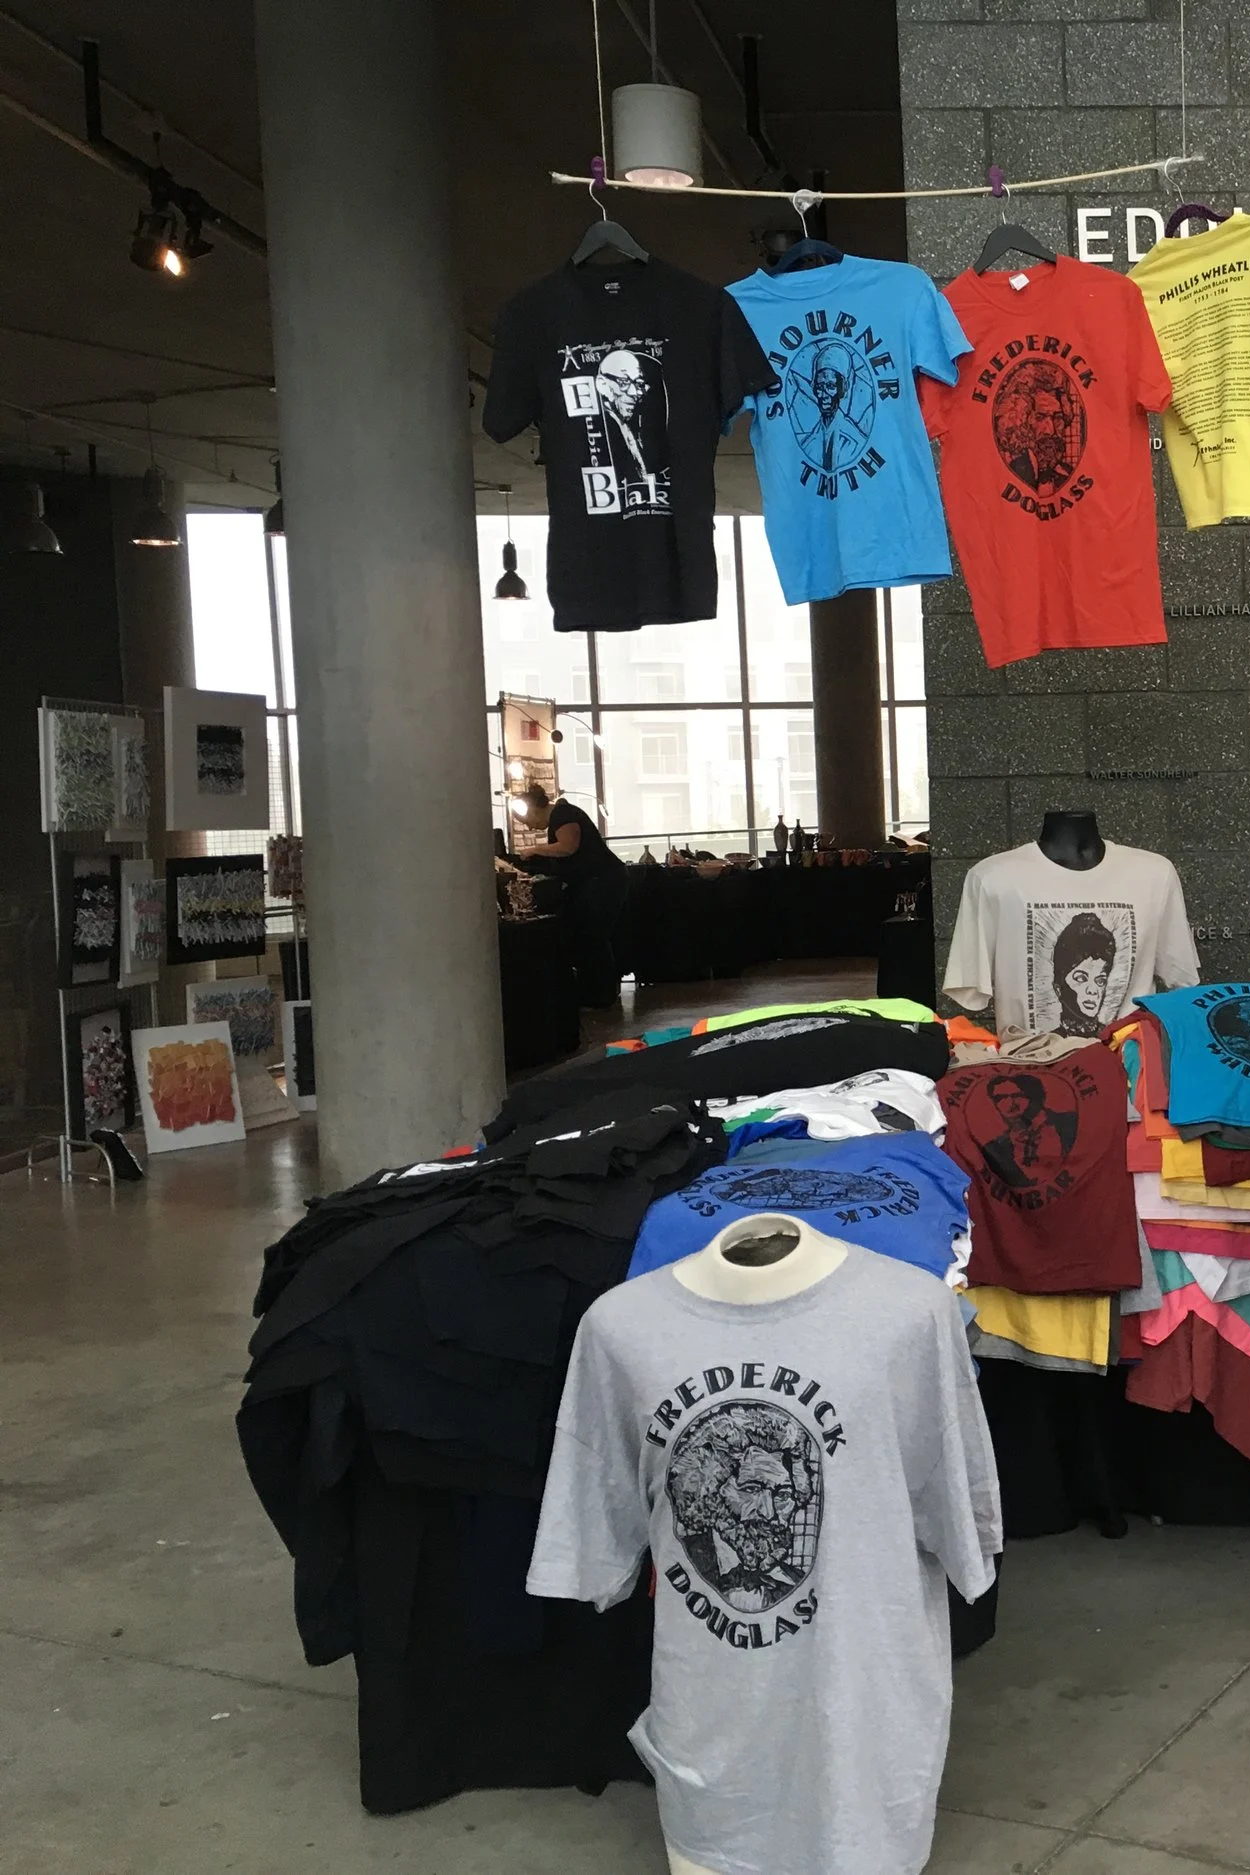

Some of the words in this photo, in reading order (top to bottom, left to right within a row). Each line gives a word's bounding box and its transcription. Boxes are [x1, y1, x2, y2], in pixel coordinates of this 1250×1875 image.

[1159, 275, 1199, 304] PHILLIS
[766, 309, 901, 420] SOJOURNER
[972, 334, 1097, 403] FREDERICK
[1170, 603, 1226, 617] LILLIAN
[1090, 769, 1134, 780] WALTER
[1222, 926, 1233, 939] &
[645, 1362, 847, 1458] FREDERICK
